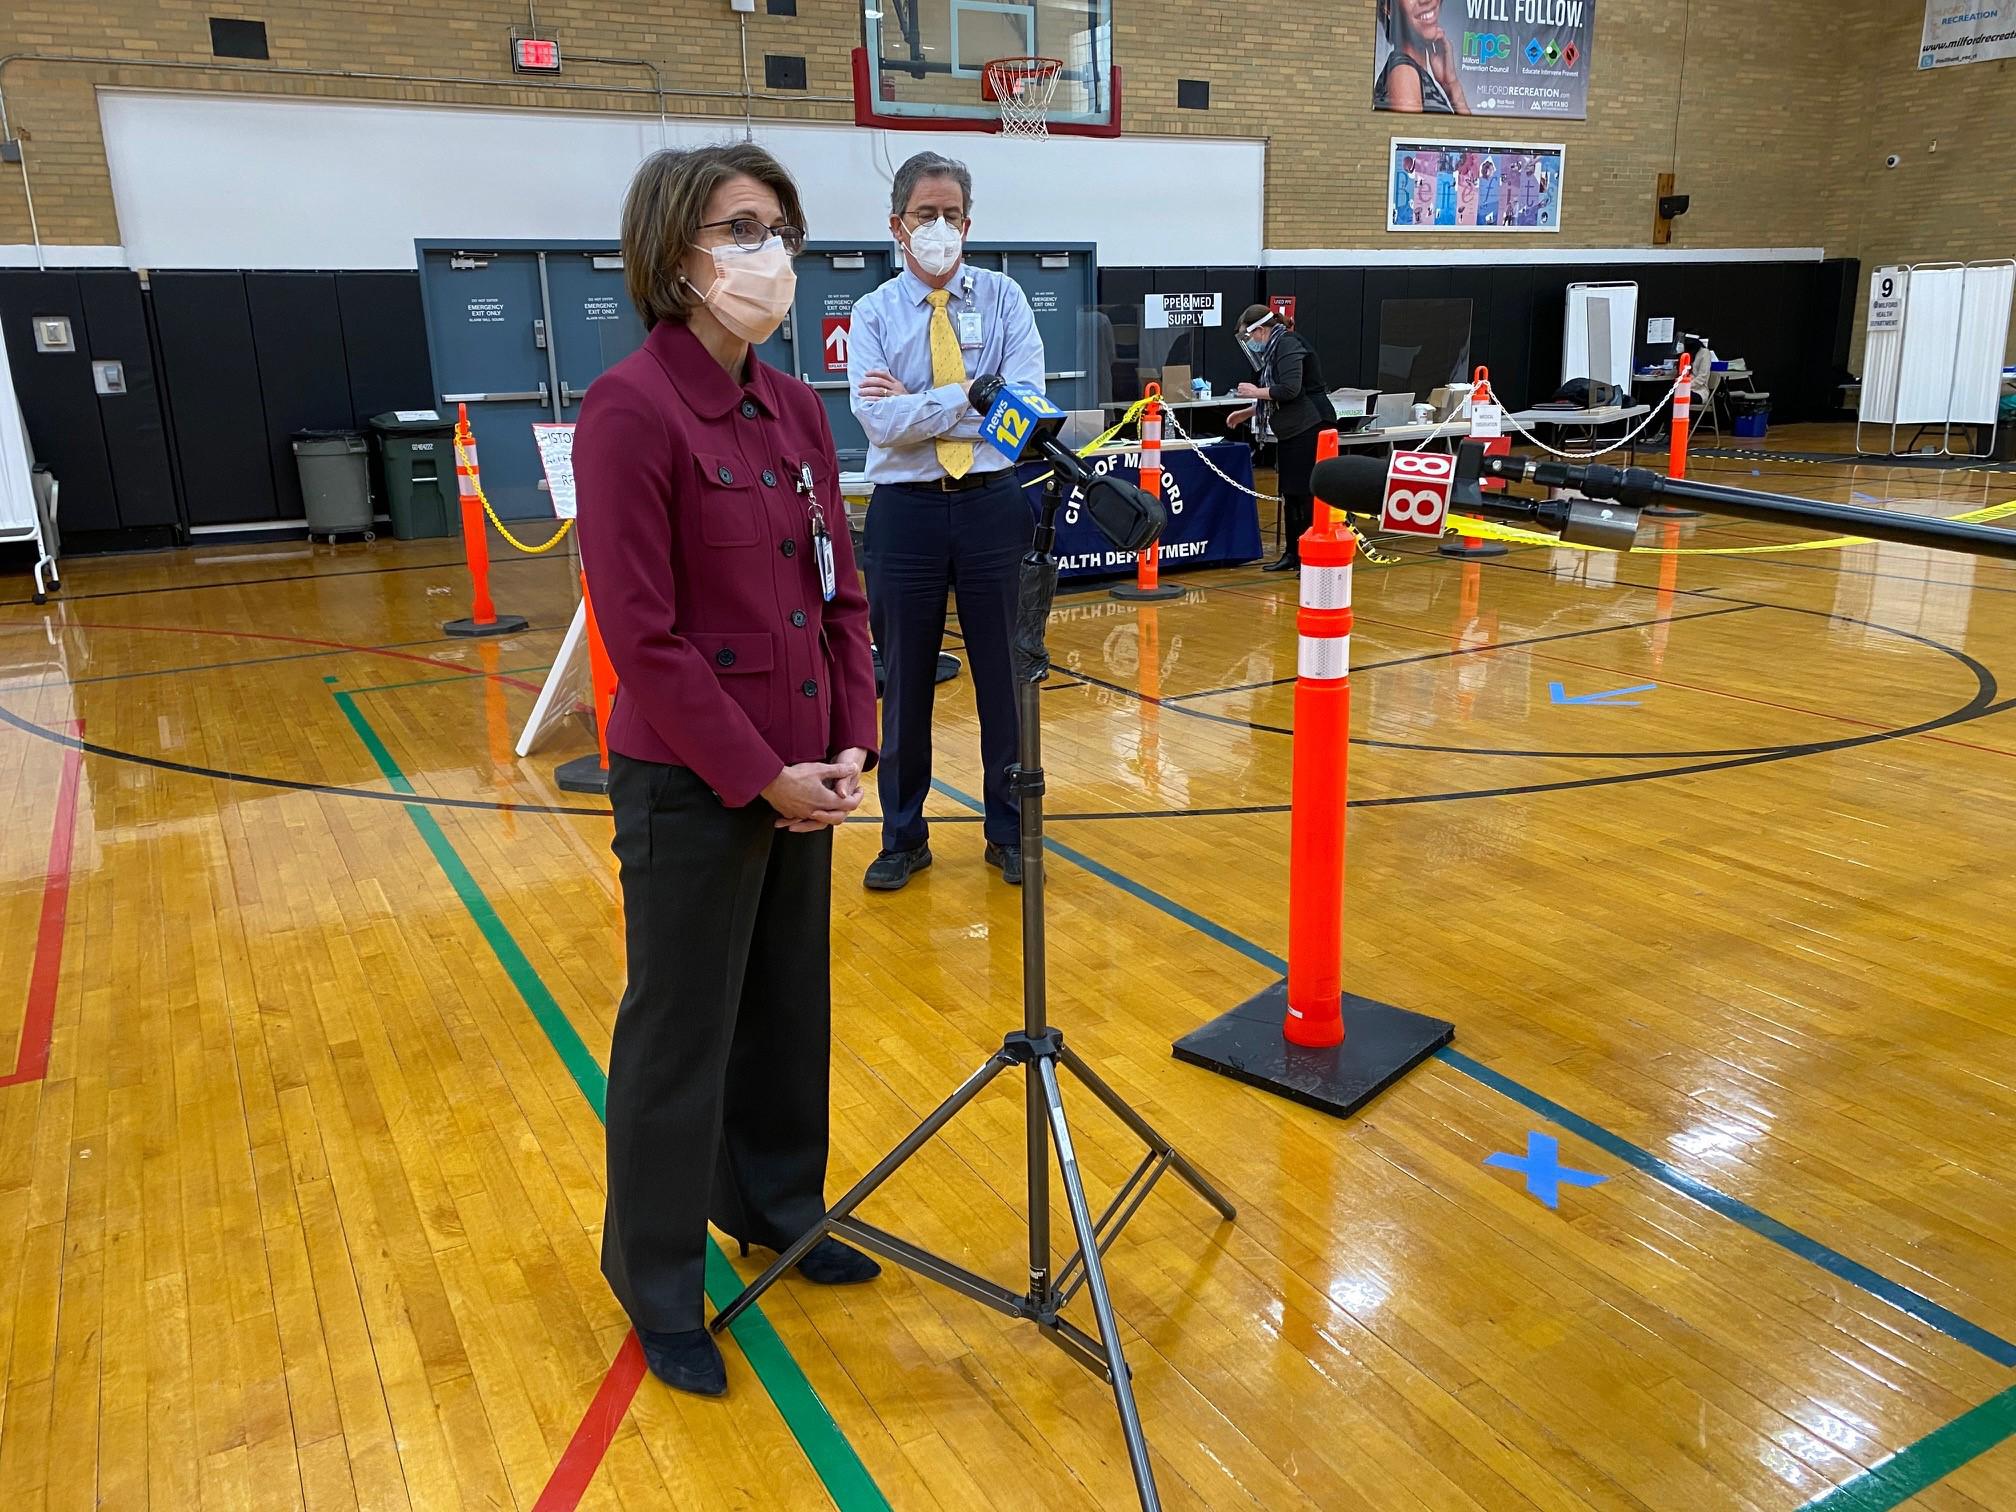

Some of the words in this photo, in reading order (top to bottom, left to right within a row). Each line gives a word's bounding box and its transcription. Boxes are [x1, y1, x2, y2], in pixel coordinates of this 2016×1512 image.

[1466, 0, 1509, 22] WILL
[1514, 0, 1583, 28] FOLLOW.
[1941, 10, 1999, 25] RECREATION
[1922, 29, 2016, 52] www.milfordrecreat
[1881, 278, 1893, 297] 9
[1163, 297, 1181, 309] PPE
[1183, 298, 1190, 308] &
[1192, 297, 1214, 308] MED.
[1168, 312, 1204, 326] SUPPLY
[1022, 395, 1059, 414] 12
[986, 399, 1008, 435] news
[996, 408, 1031, 449] 12
[1094, 454, 1118, 476] OF
[1124, 453, 1184, 515] MORD
[1052, 552, 1101, 570] ALTH
[1105, 540, 1209, 566] DEPTMENT
